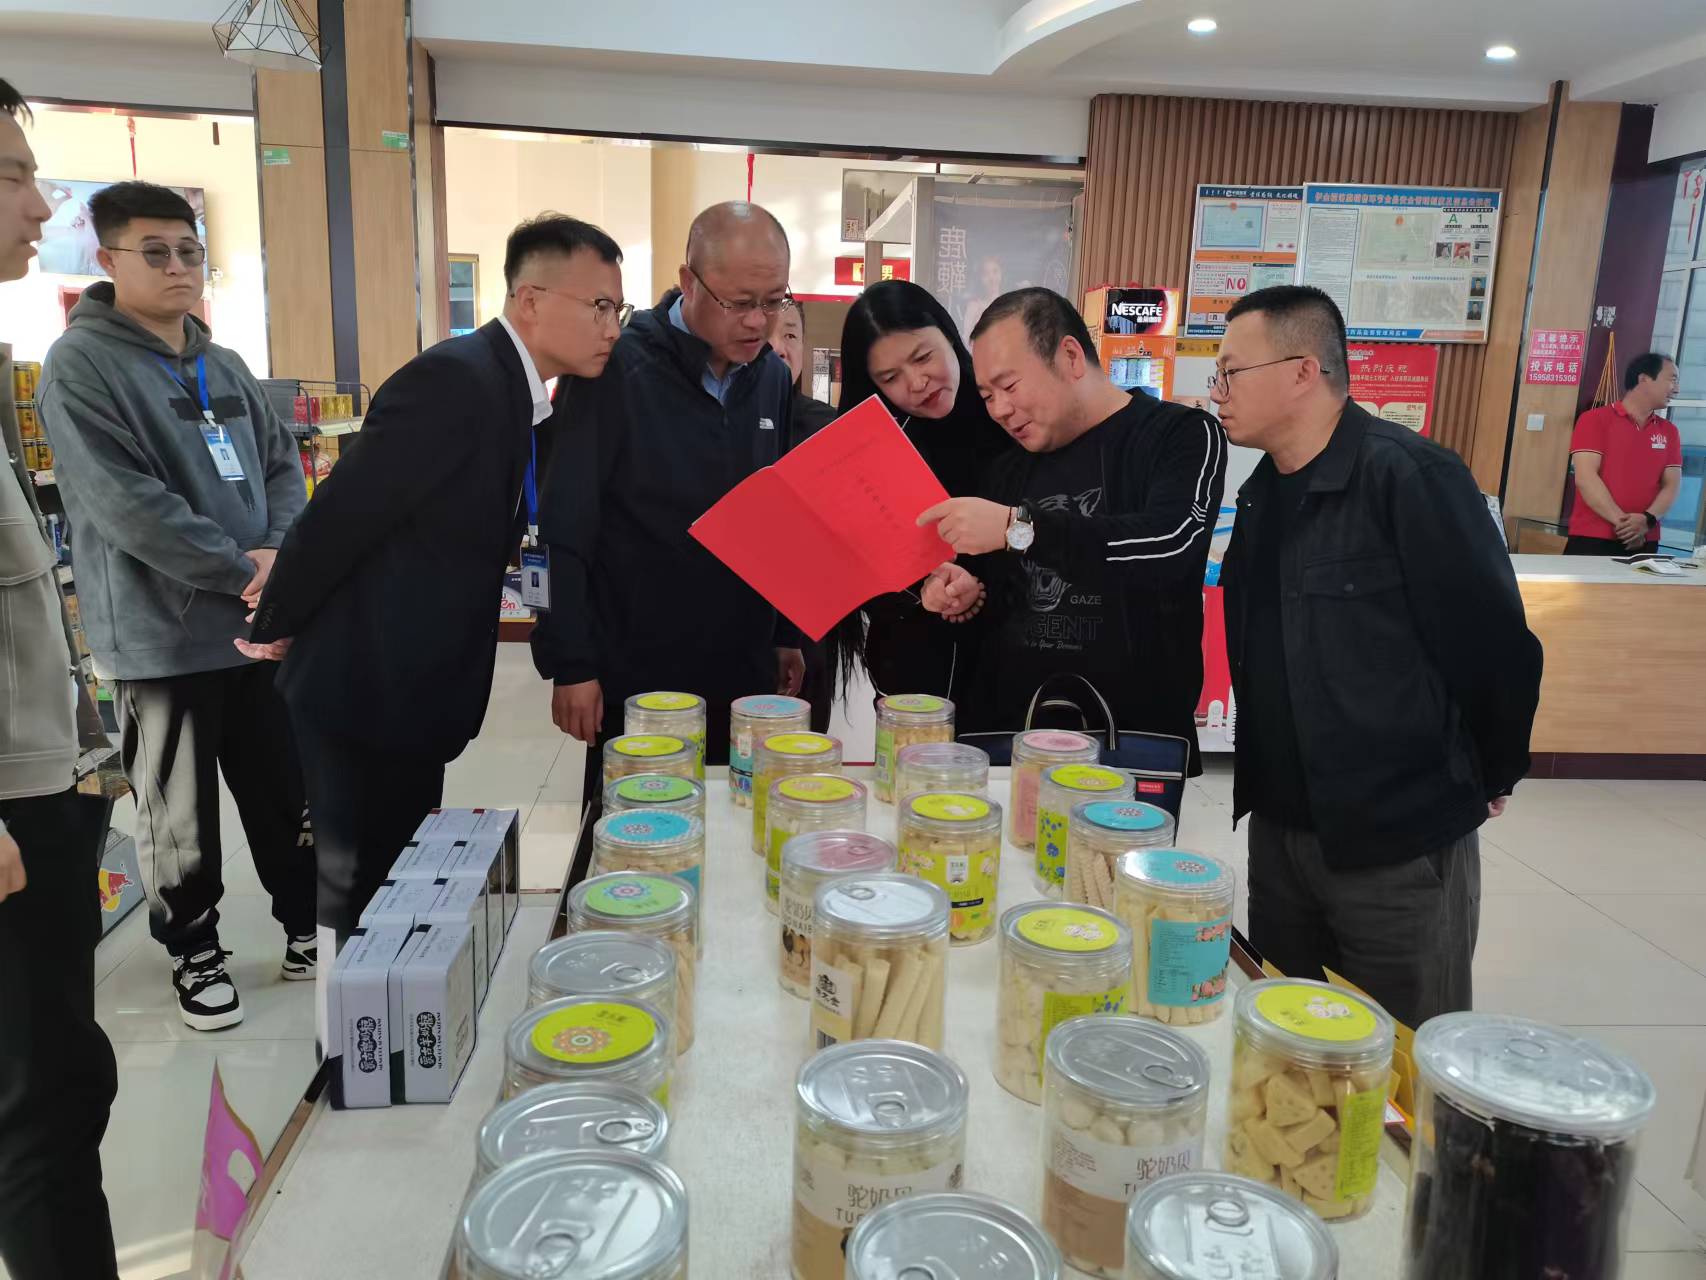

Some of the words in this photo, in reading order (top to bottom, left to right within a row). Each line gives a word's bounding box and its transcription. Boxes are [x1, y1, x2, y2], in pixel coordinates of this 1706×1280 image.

[1449, 214, 1458, 223] A
[1477, 214, 1483, 223] 1
[881, 264, 894, 280] 男
[1226, 277, 1246, 290] NO
[1530, 361, 1578, 373] 投诉电话
[1070, 595, 1102, 605] GAZE
